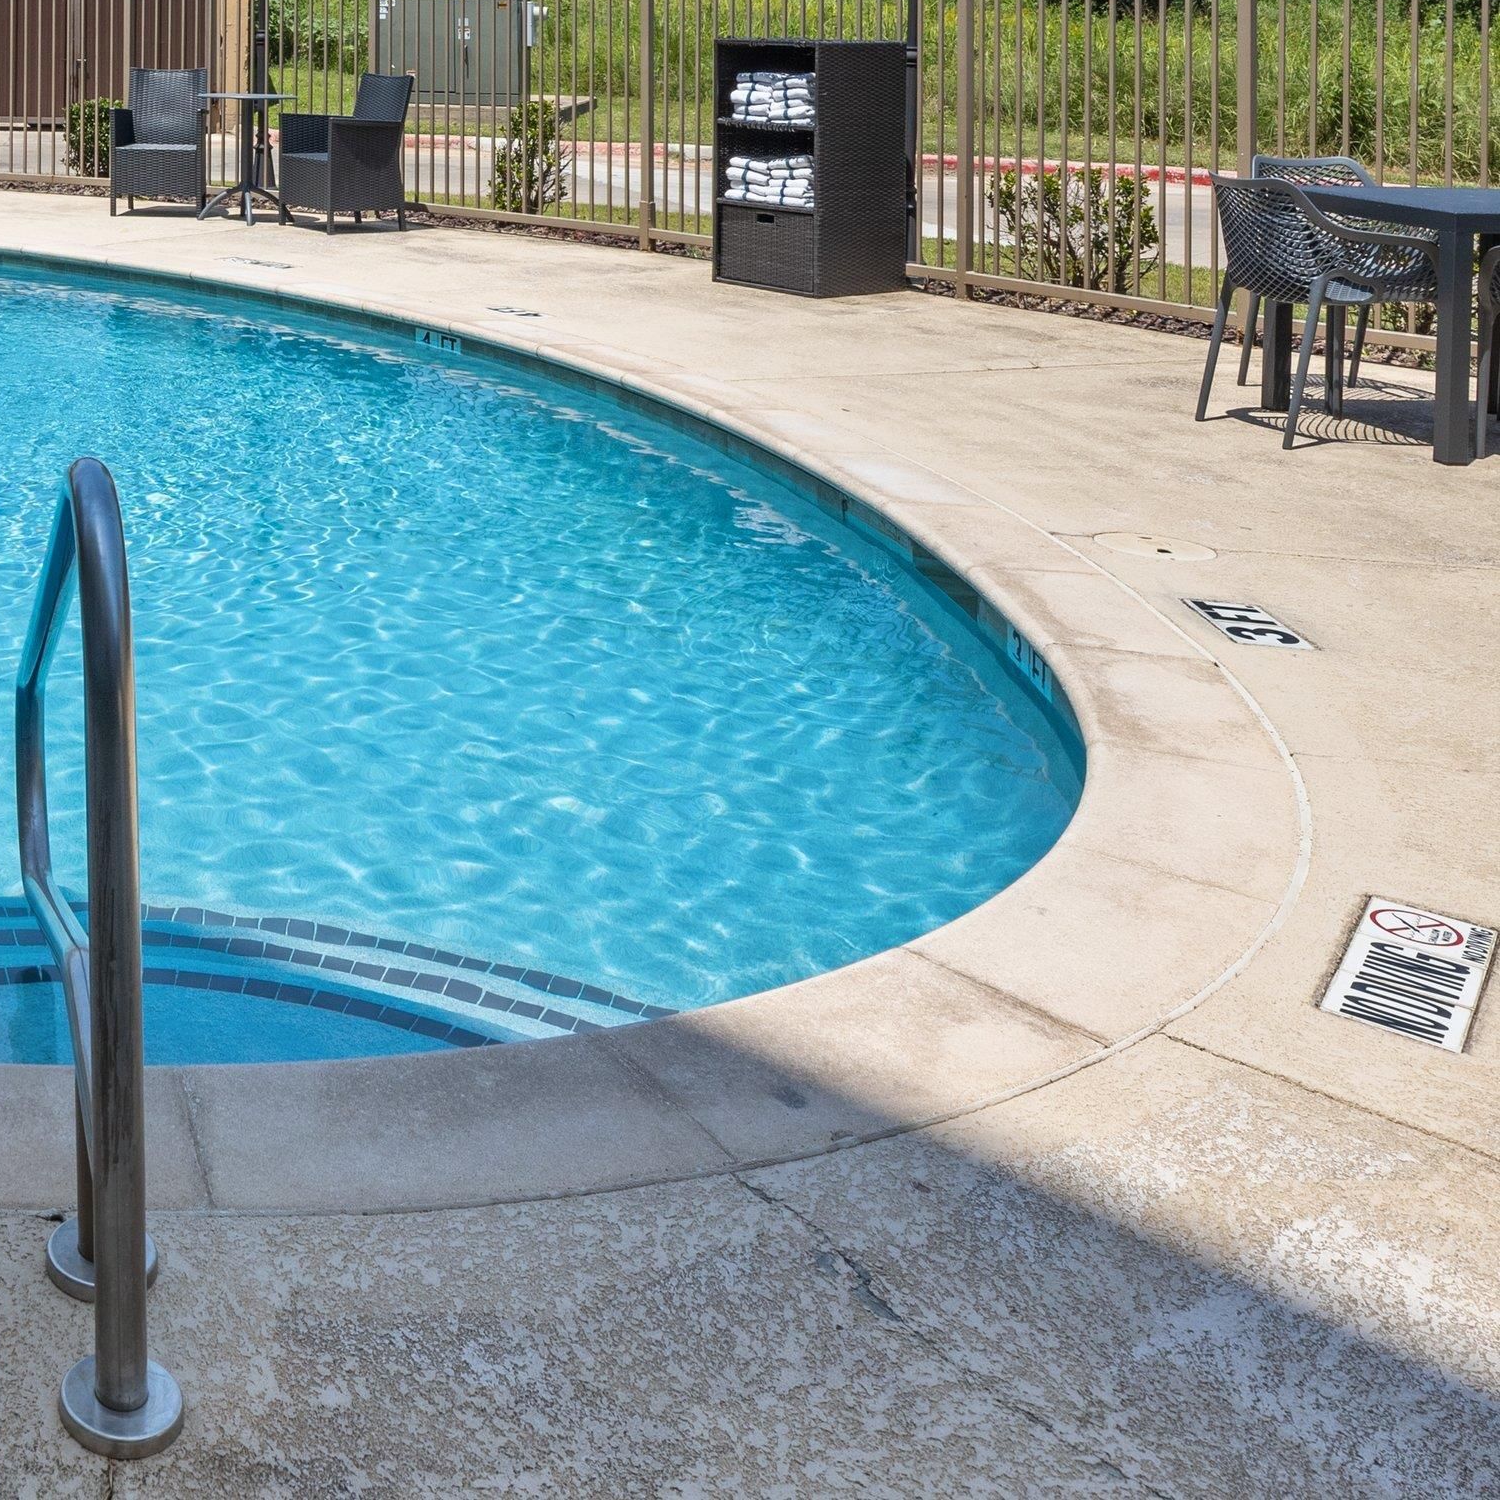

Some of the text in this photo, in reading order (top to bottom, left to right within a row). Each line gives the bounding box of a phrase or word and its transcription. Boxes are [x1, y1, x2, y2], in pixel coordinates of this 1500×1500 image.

[1225, 626, 1300, 645] 3
[1461, 927, 1494, 965] NO DIVING
[1339, 941, 1471, 1045] NO DIVING
